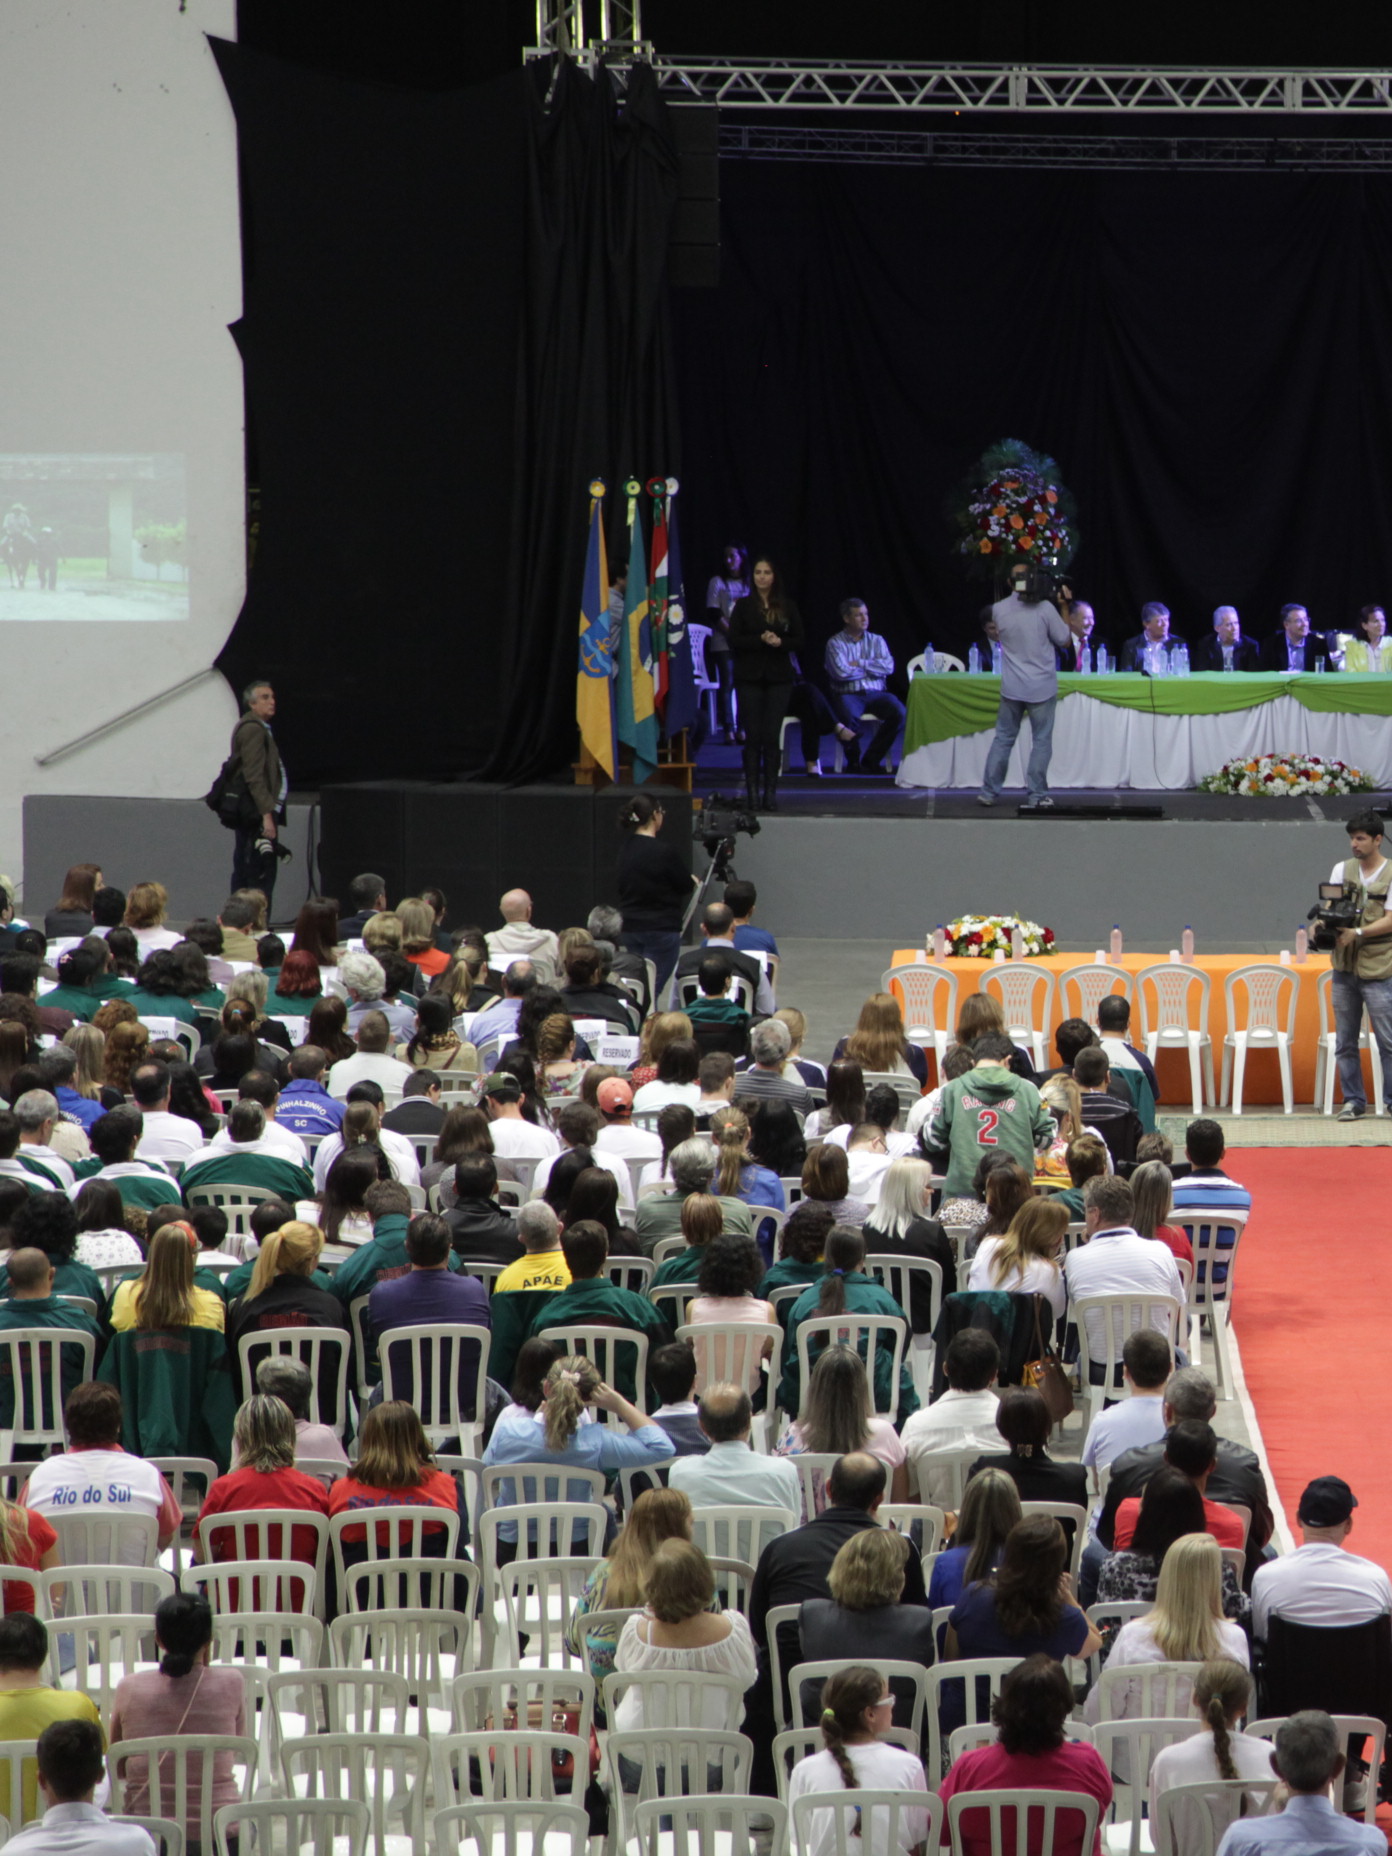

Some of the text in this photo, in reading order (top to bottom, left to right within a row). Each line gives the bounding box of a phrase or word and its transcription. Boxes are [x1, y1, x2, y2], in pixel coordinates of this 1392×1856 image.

[602, 1047, 632, 1059] RESERVADO
[275, 1100, 327, 1115] PINHALZINHO
[294, 1119, 308, 1127] SC
[977, 1109, 999, 1145] 2
[522, 1275, 563, 1289] APAE
[52, 1484, 131, 1505] Rio do Sul
